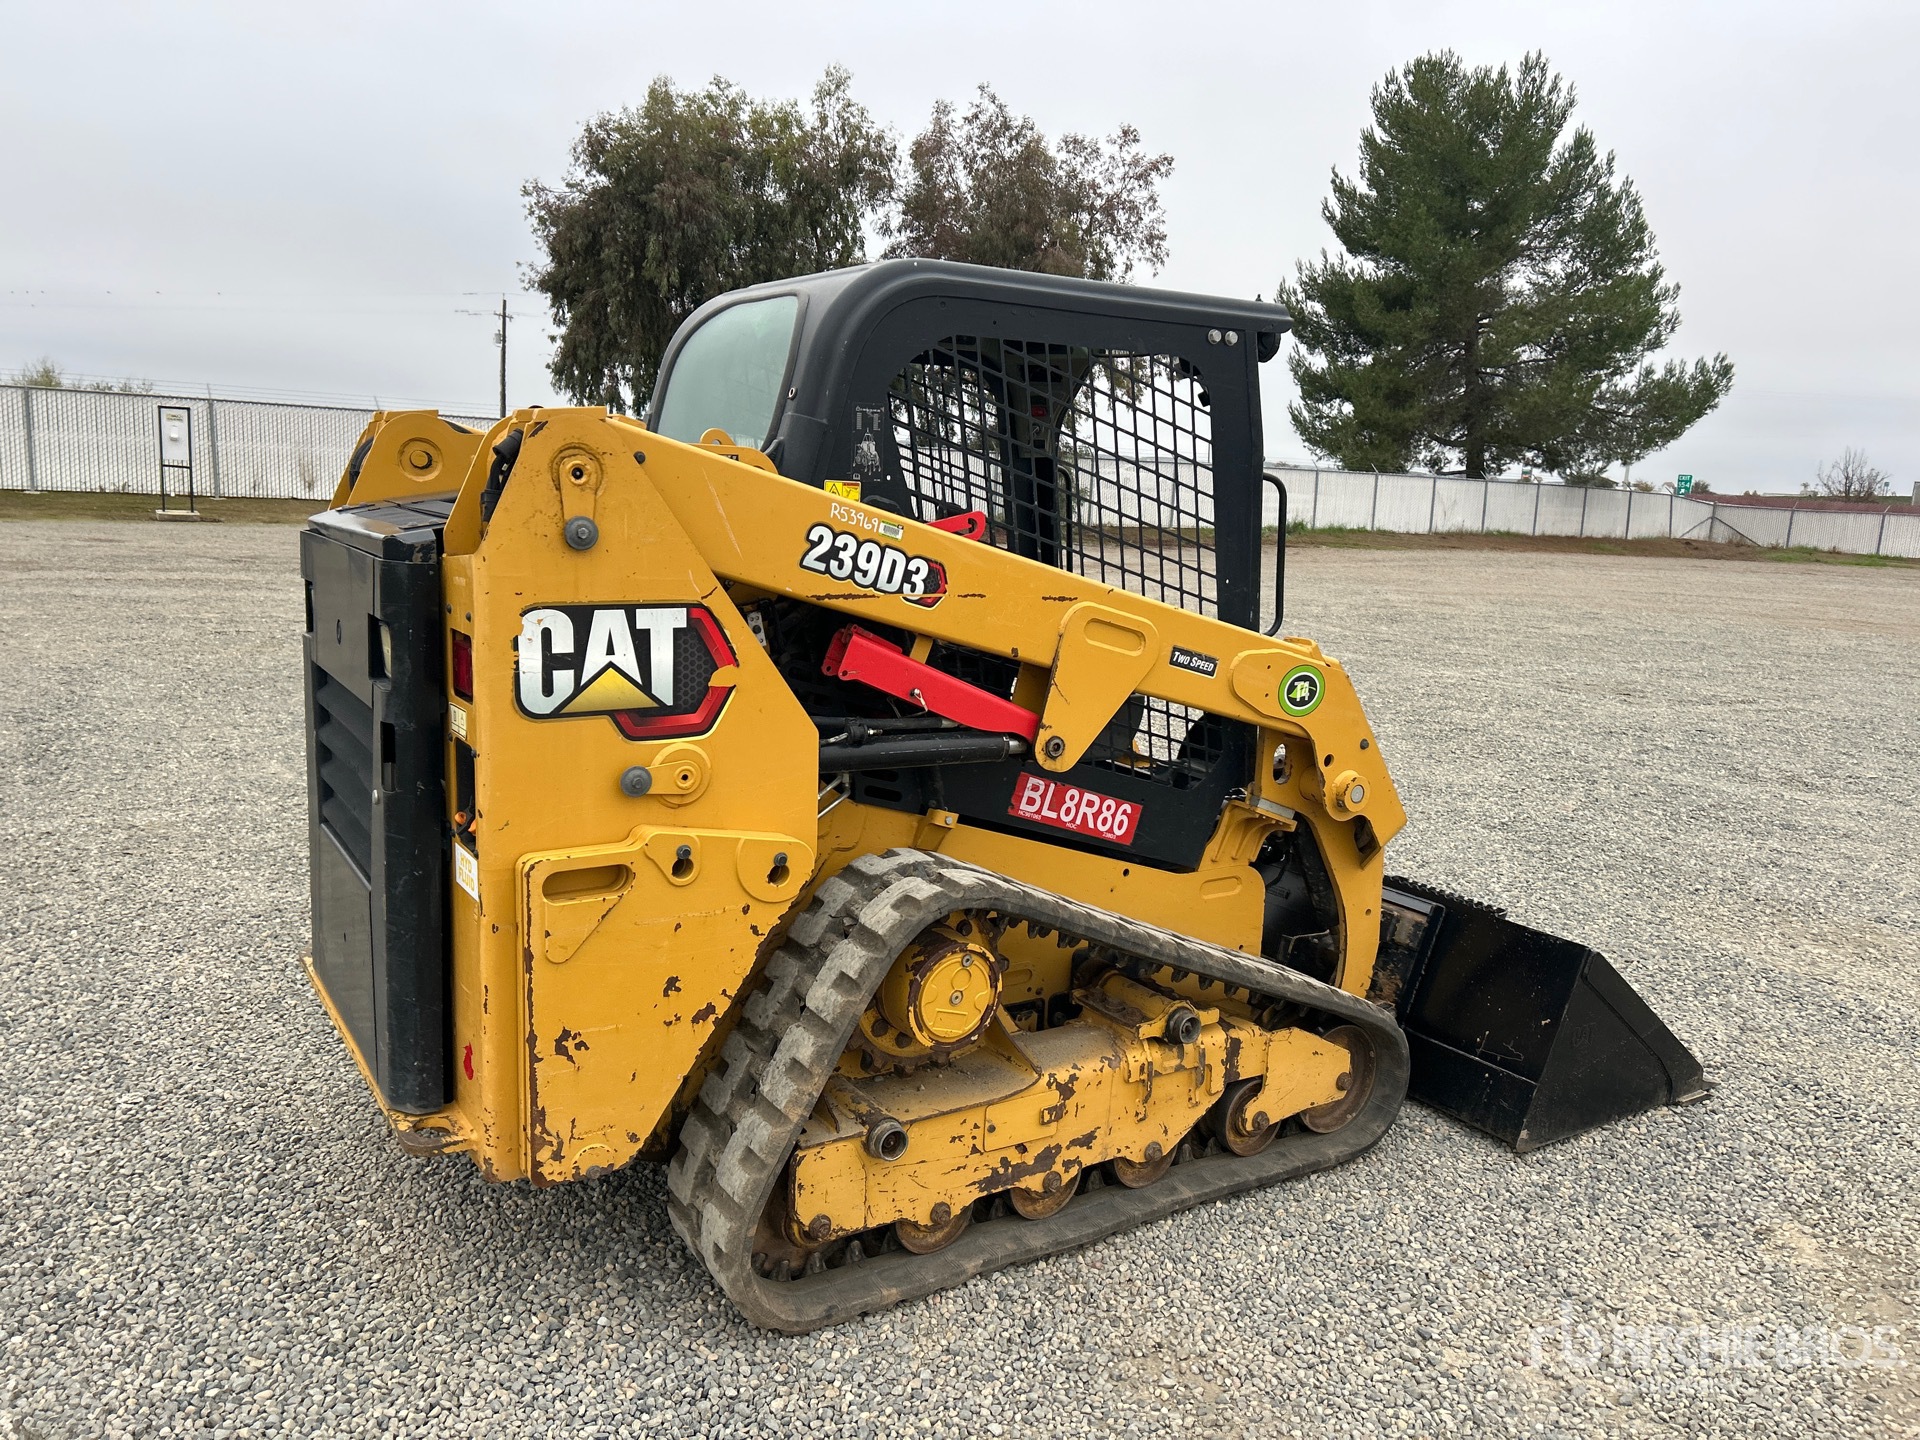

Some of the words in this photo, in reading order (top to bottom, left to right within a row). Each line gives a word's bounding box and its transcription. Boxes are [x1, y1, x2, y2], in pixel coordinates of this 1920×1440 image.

[830, 502, 879, 533] R53969
[802, 525, 929, 601] 239D3
[518, 607, 687, 715] CAT
[1172, 651, 1190, 665] TWO
[1190, 656, 1215, 672] SPEED
[1019, 776, 1132, 836] BL8R86
[458, 865, 475, 892] FLUID
[460, 852, 472, 874] HYD
